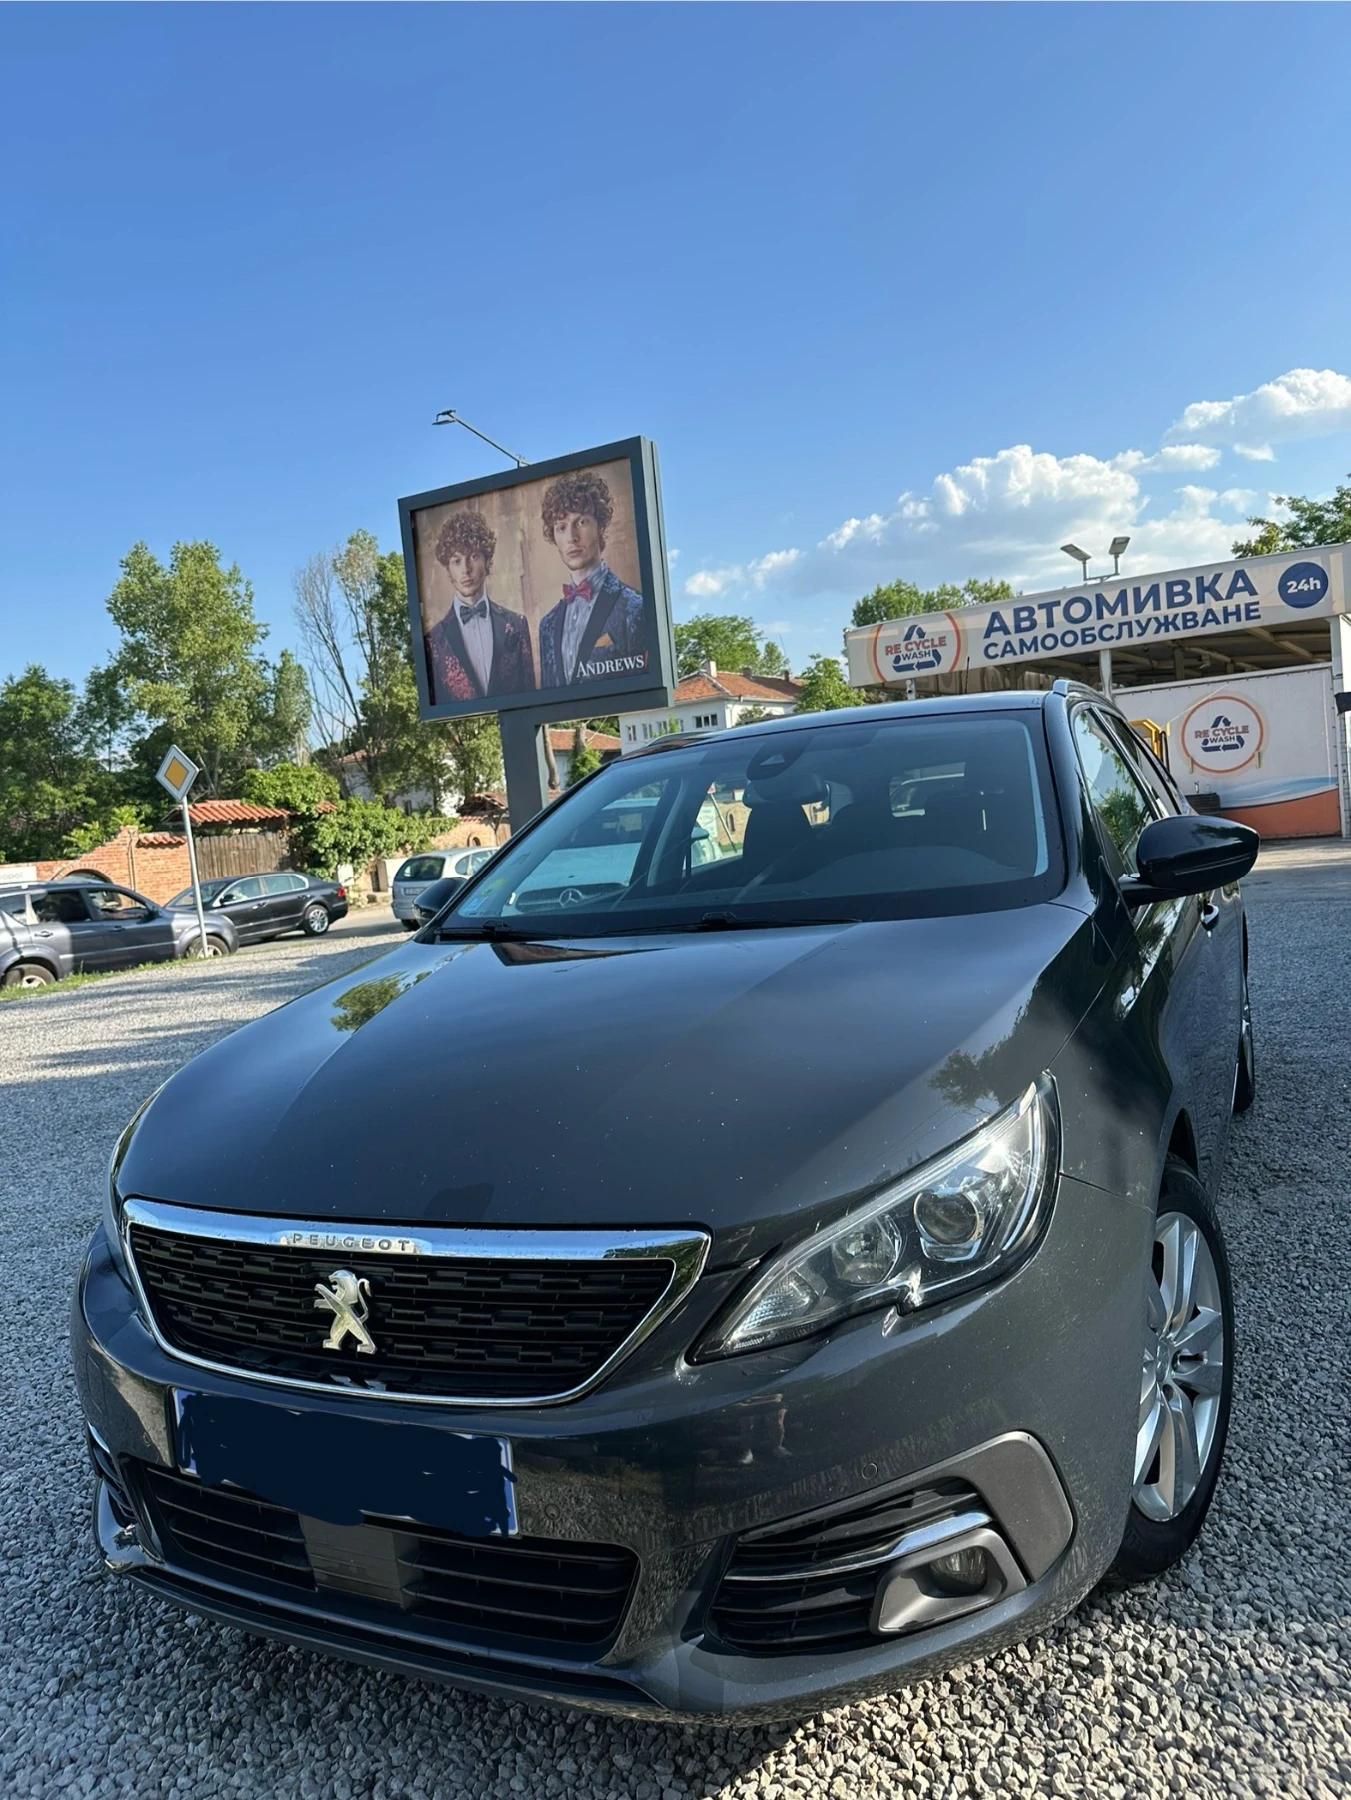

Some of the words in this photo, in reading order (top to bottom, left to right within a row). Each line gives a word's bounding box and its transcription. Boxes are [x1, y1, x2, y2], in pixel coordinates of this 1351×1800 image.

[1286, 577, 1321, 594] 24h
[983, 568, 1259, 640] АВТОМИВКА
[983, 601, 1262, 660] САМООБСЛУЖВАНЕ
[885, 643, 902, 656] RE
[904, 636, 947, 653] CYCLE
[901, 650, 931, 661] WASH
[576, 654, 645, 678] ANDREWS
[1194, 729, 1210, 739] RE
[1212, 725, 1249, 737] CYCLE
[1209, 735, 1236, 744] WASH
[292, 1233, 410, 1252] PEUGEOT
